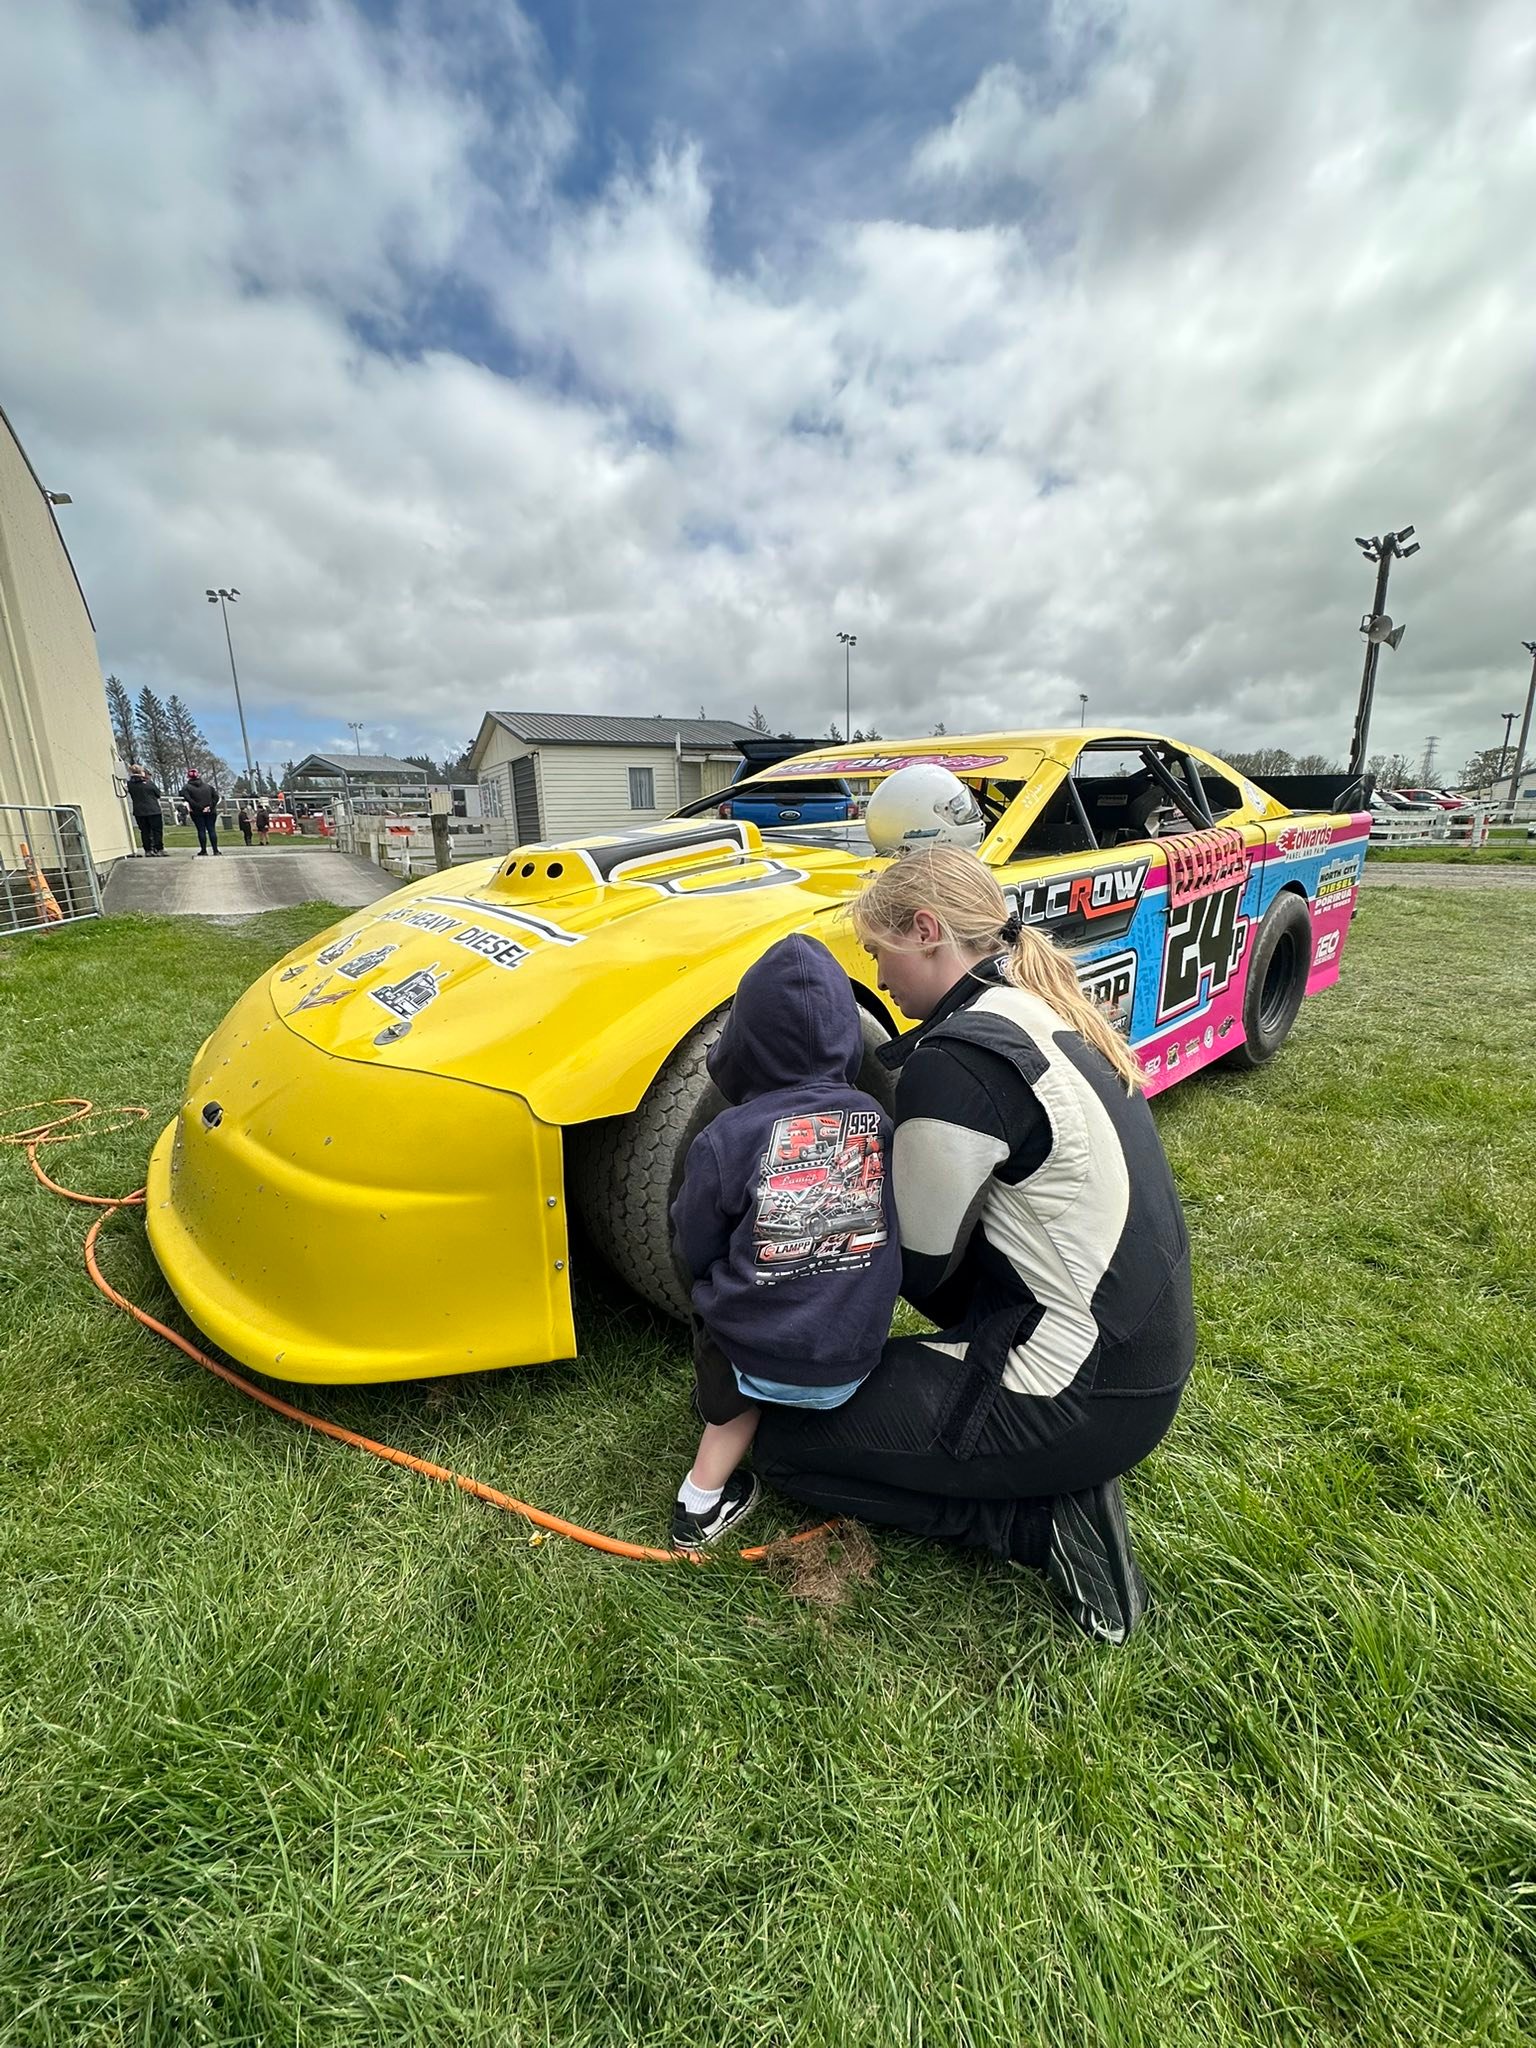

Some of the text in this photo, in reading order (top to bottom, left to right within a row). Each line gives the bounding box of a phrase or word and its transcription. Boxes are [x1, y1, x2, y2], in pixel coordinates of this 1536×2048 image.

[1286, 851, 1302, 860] PANEL
[1303, 849, 1313, 857] AND
[1319, 865, 1358, 882] NORTH CITY
[1319, 878, 1353, 896] DIESEL
[1315, 889, 1352, 909] PORIRUA
[404, 911, 463, 934] HEAVY
[454, 927, 530, 969] DIESEL
[775, 1241, 811, 1255] LAMPP
